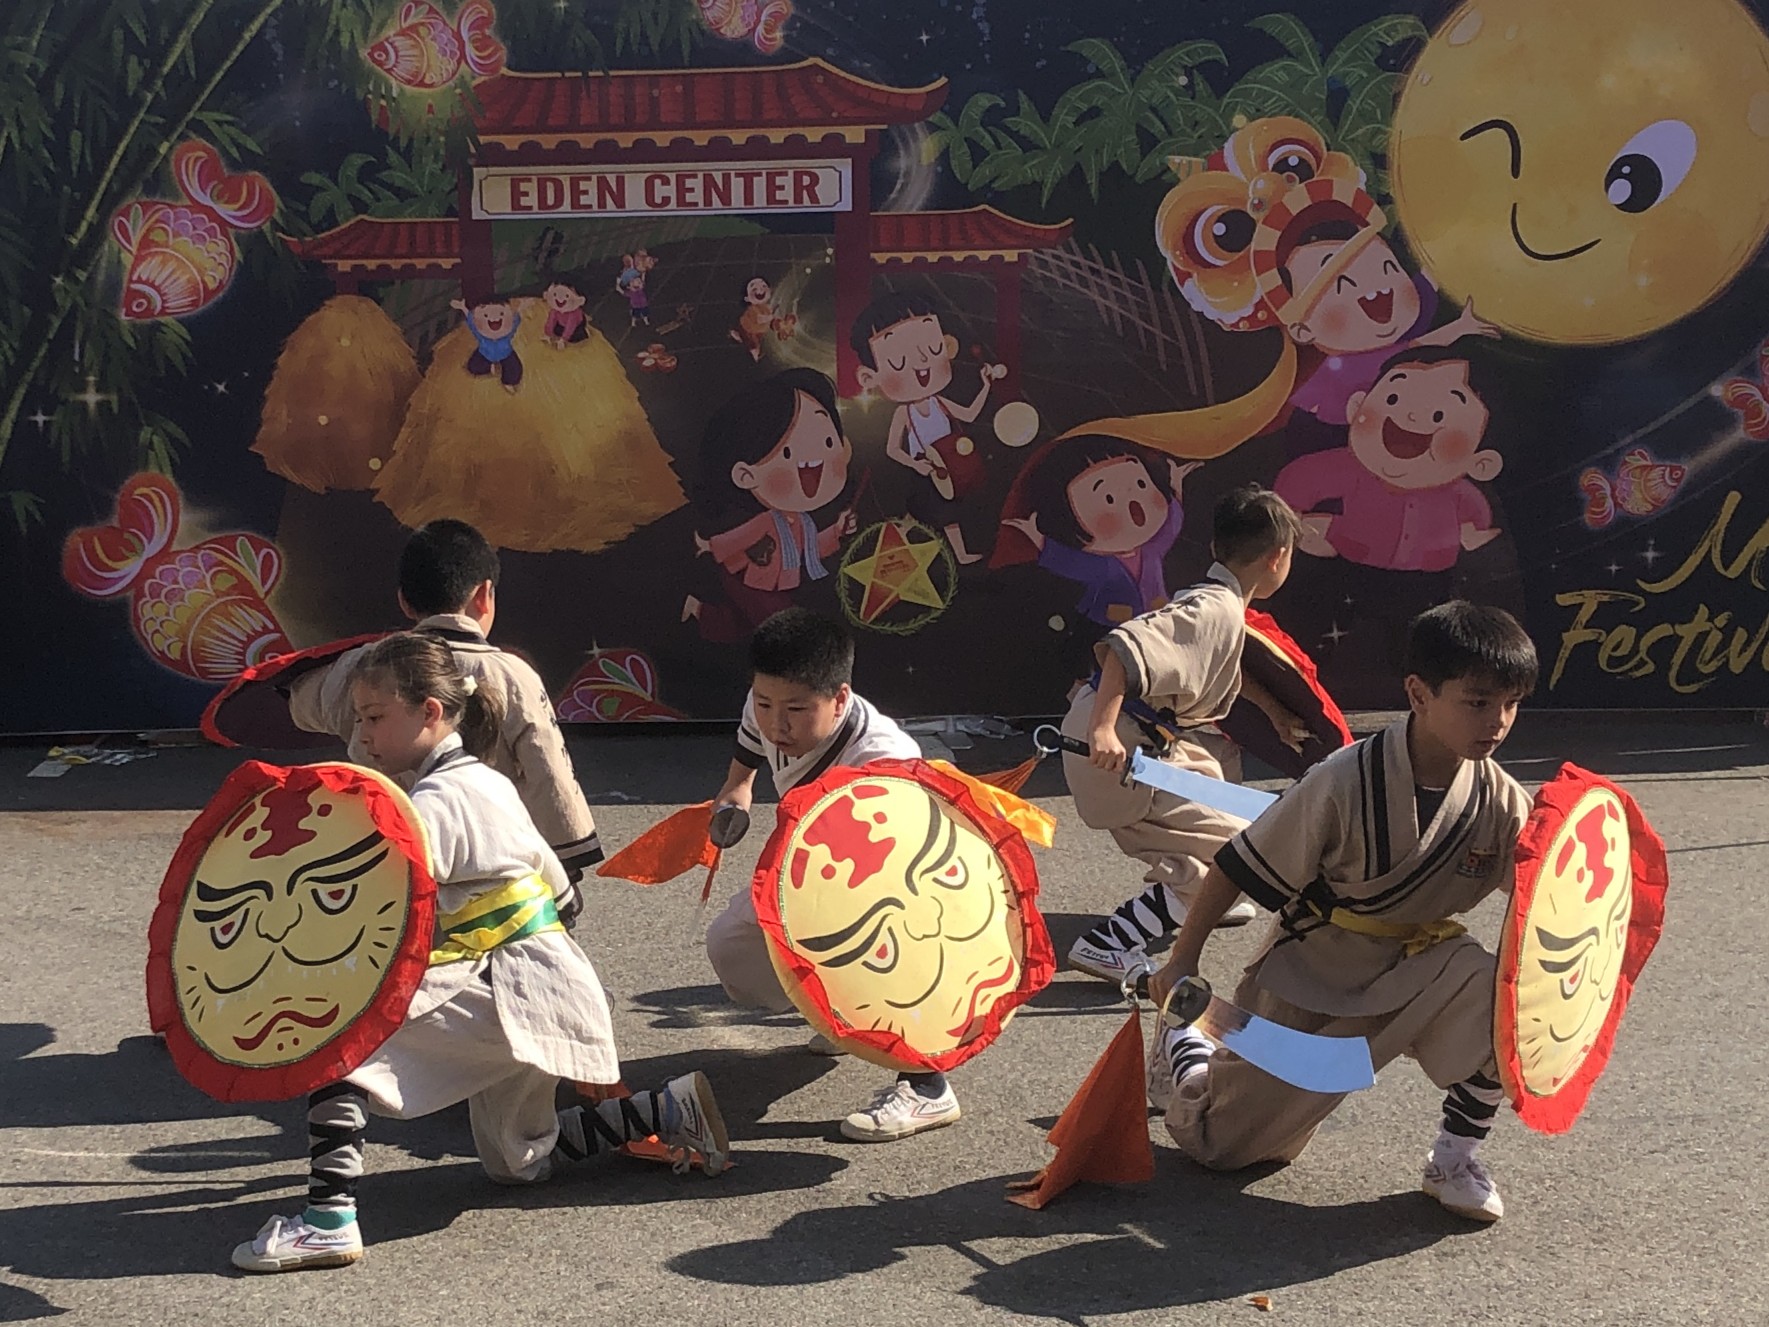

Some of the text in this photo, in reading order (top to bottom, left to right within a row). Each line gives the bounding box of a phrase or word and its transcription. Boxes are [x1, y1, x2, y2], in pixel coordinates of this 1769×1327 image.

[509, 170, 822, 212] EDEN CENTER
[1549, 590, 1769, 694] Festiv
